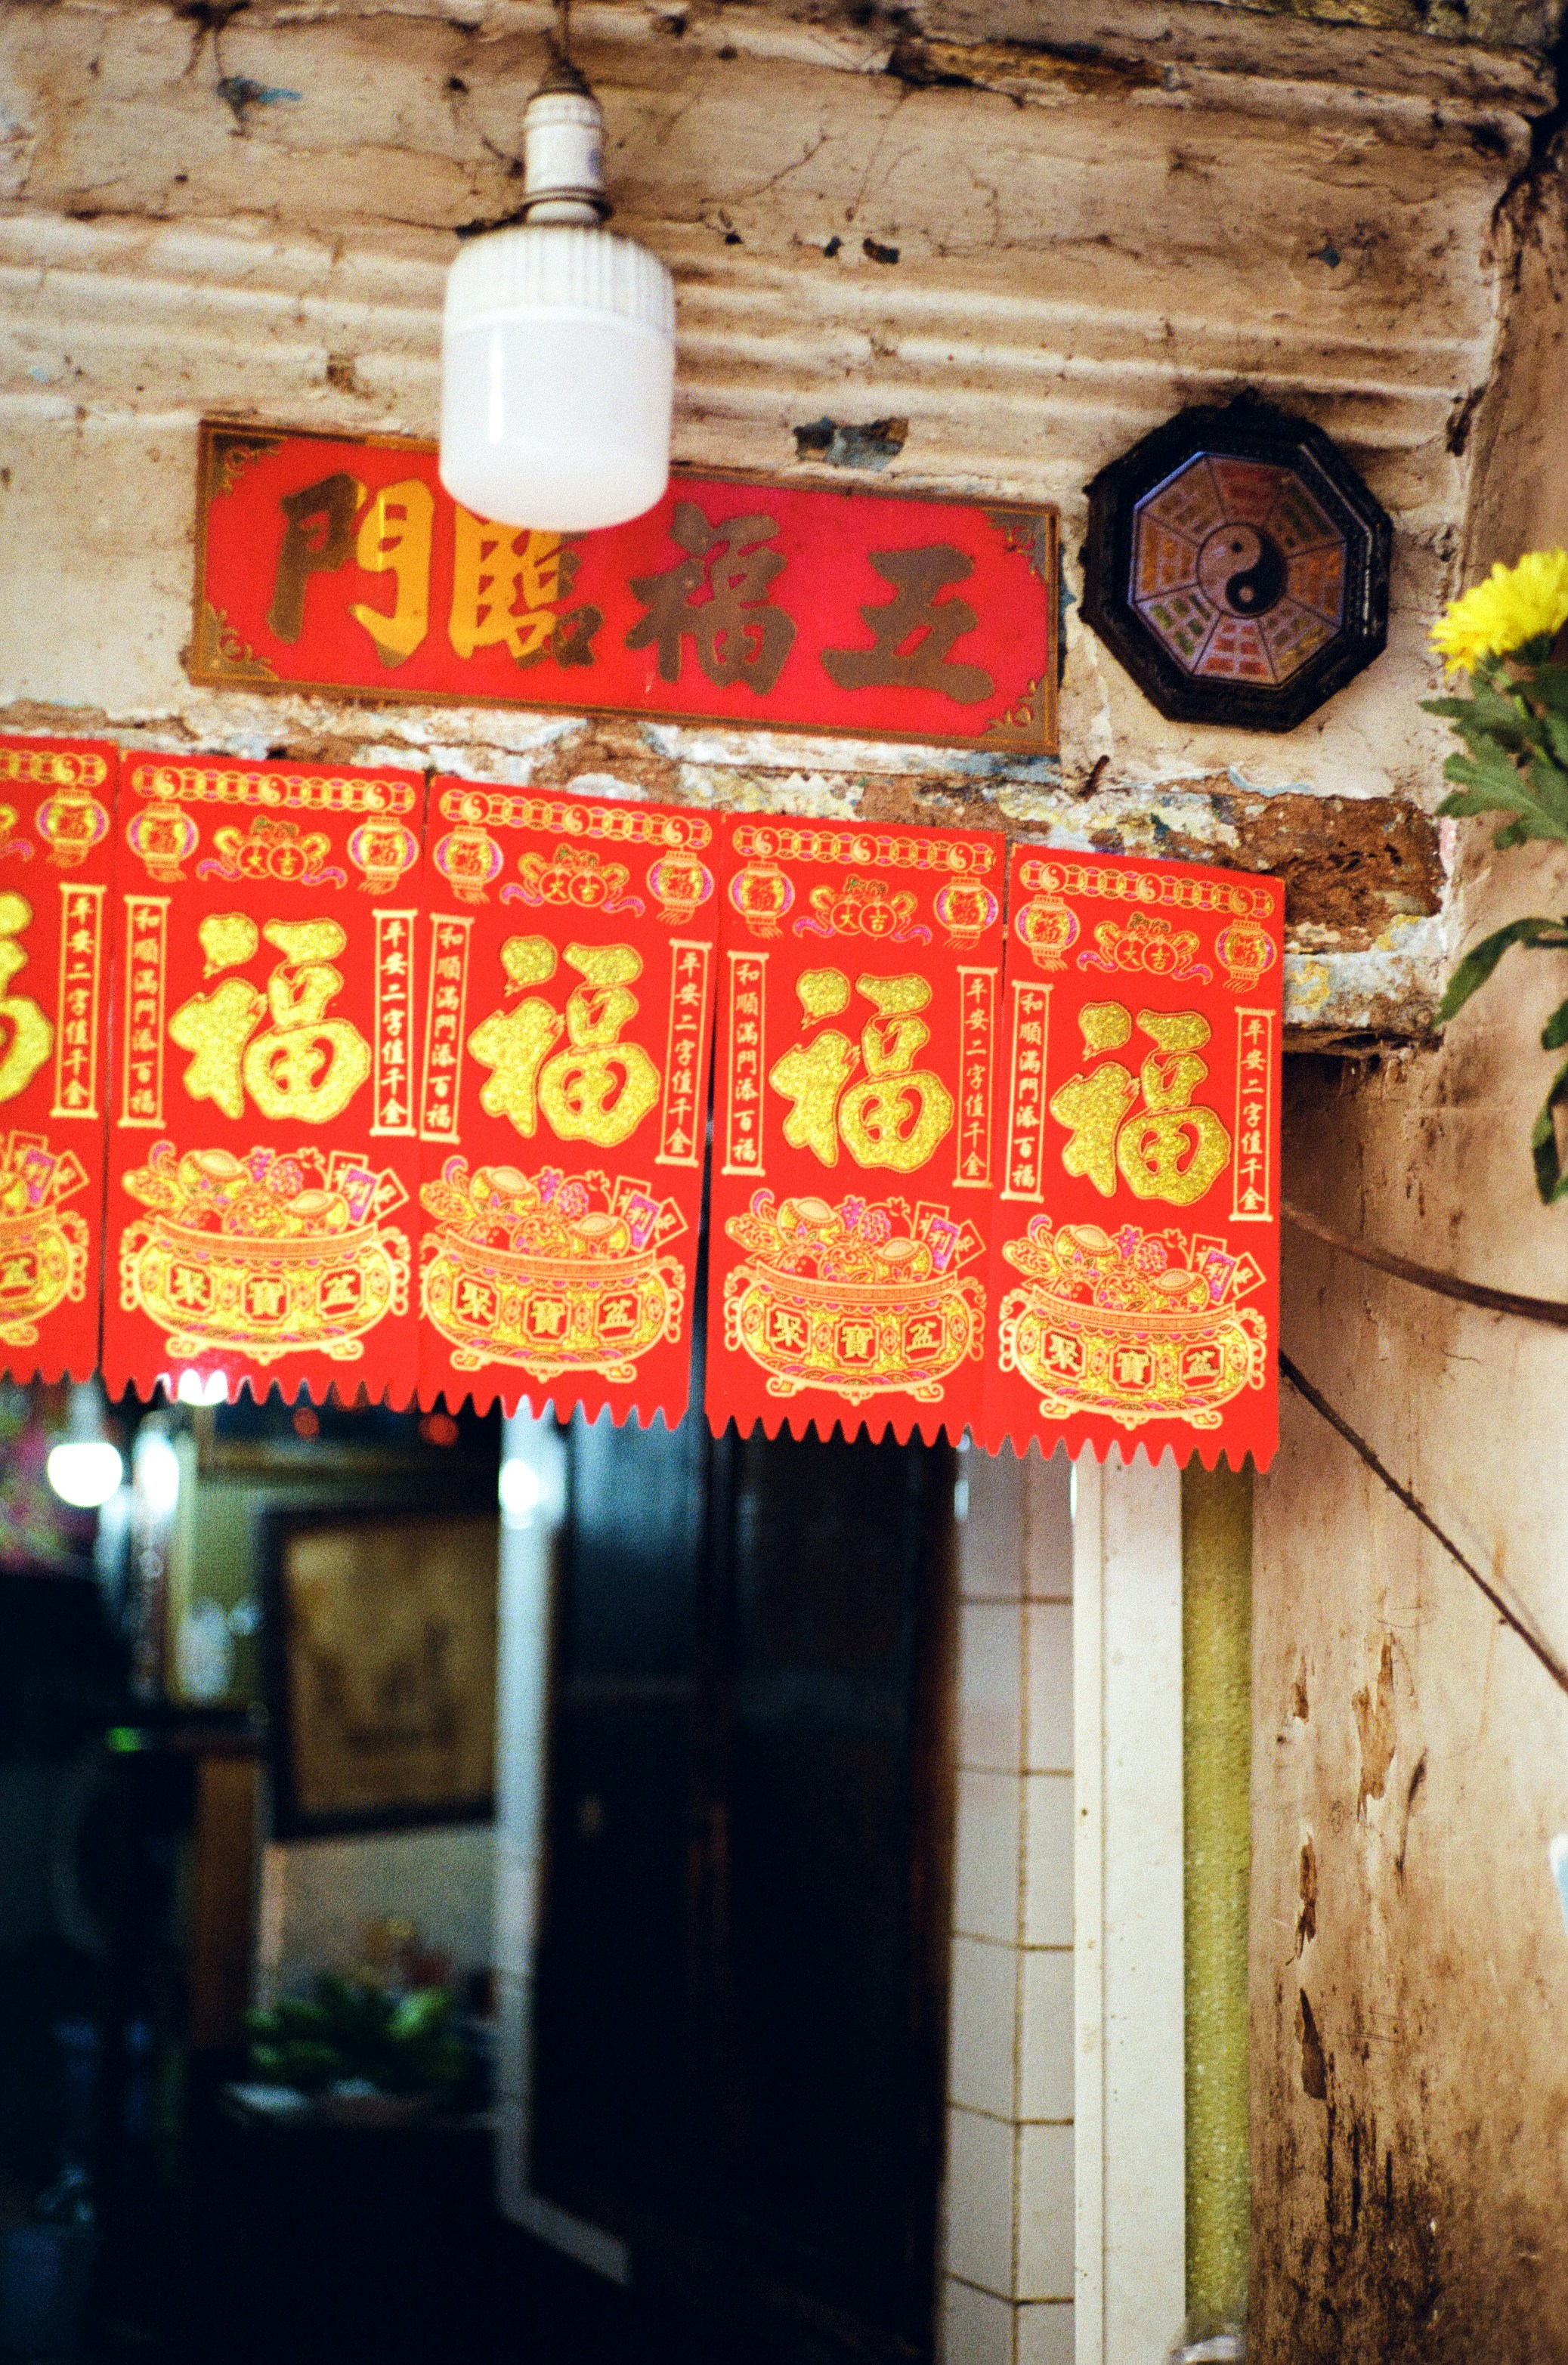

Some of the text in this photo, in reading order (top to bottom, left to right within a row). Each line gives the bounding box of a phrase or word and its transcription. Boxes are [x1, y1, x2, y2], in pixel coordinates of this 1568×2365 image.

[169, 911, 372, 1124] 福
[839, 905, 889, 932] 大吉
[1122, 943, 1171, 970] 大吉
[379, 920, 409, 1124] 平安二字值千金
[468, 934, 662, 1148] 福
[666, 951, 703, 1154] 平安二字值千金
[769, 966, 954, 1173] 福
[960, 977, 988, 1176] 平安二字值千金
[1050, 1000, 1232, 1207] 福
[1237, 1019, 1266, 1211] 平安二字值千金
[461, 1281, 635, 1336] 聚寶盆
[773, 1311, 941, 1359] 聚寶盆
[1049, 1334, 1220, 1384] 聚寶盆
